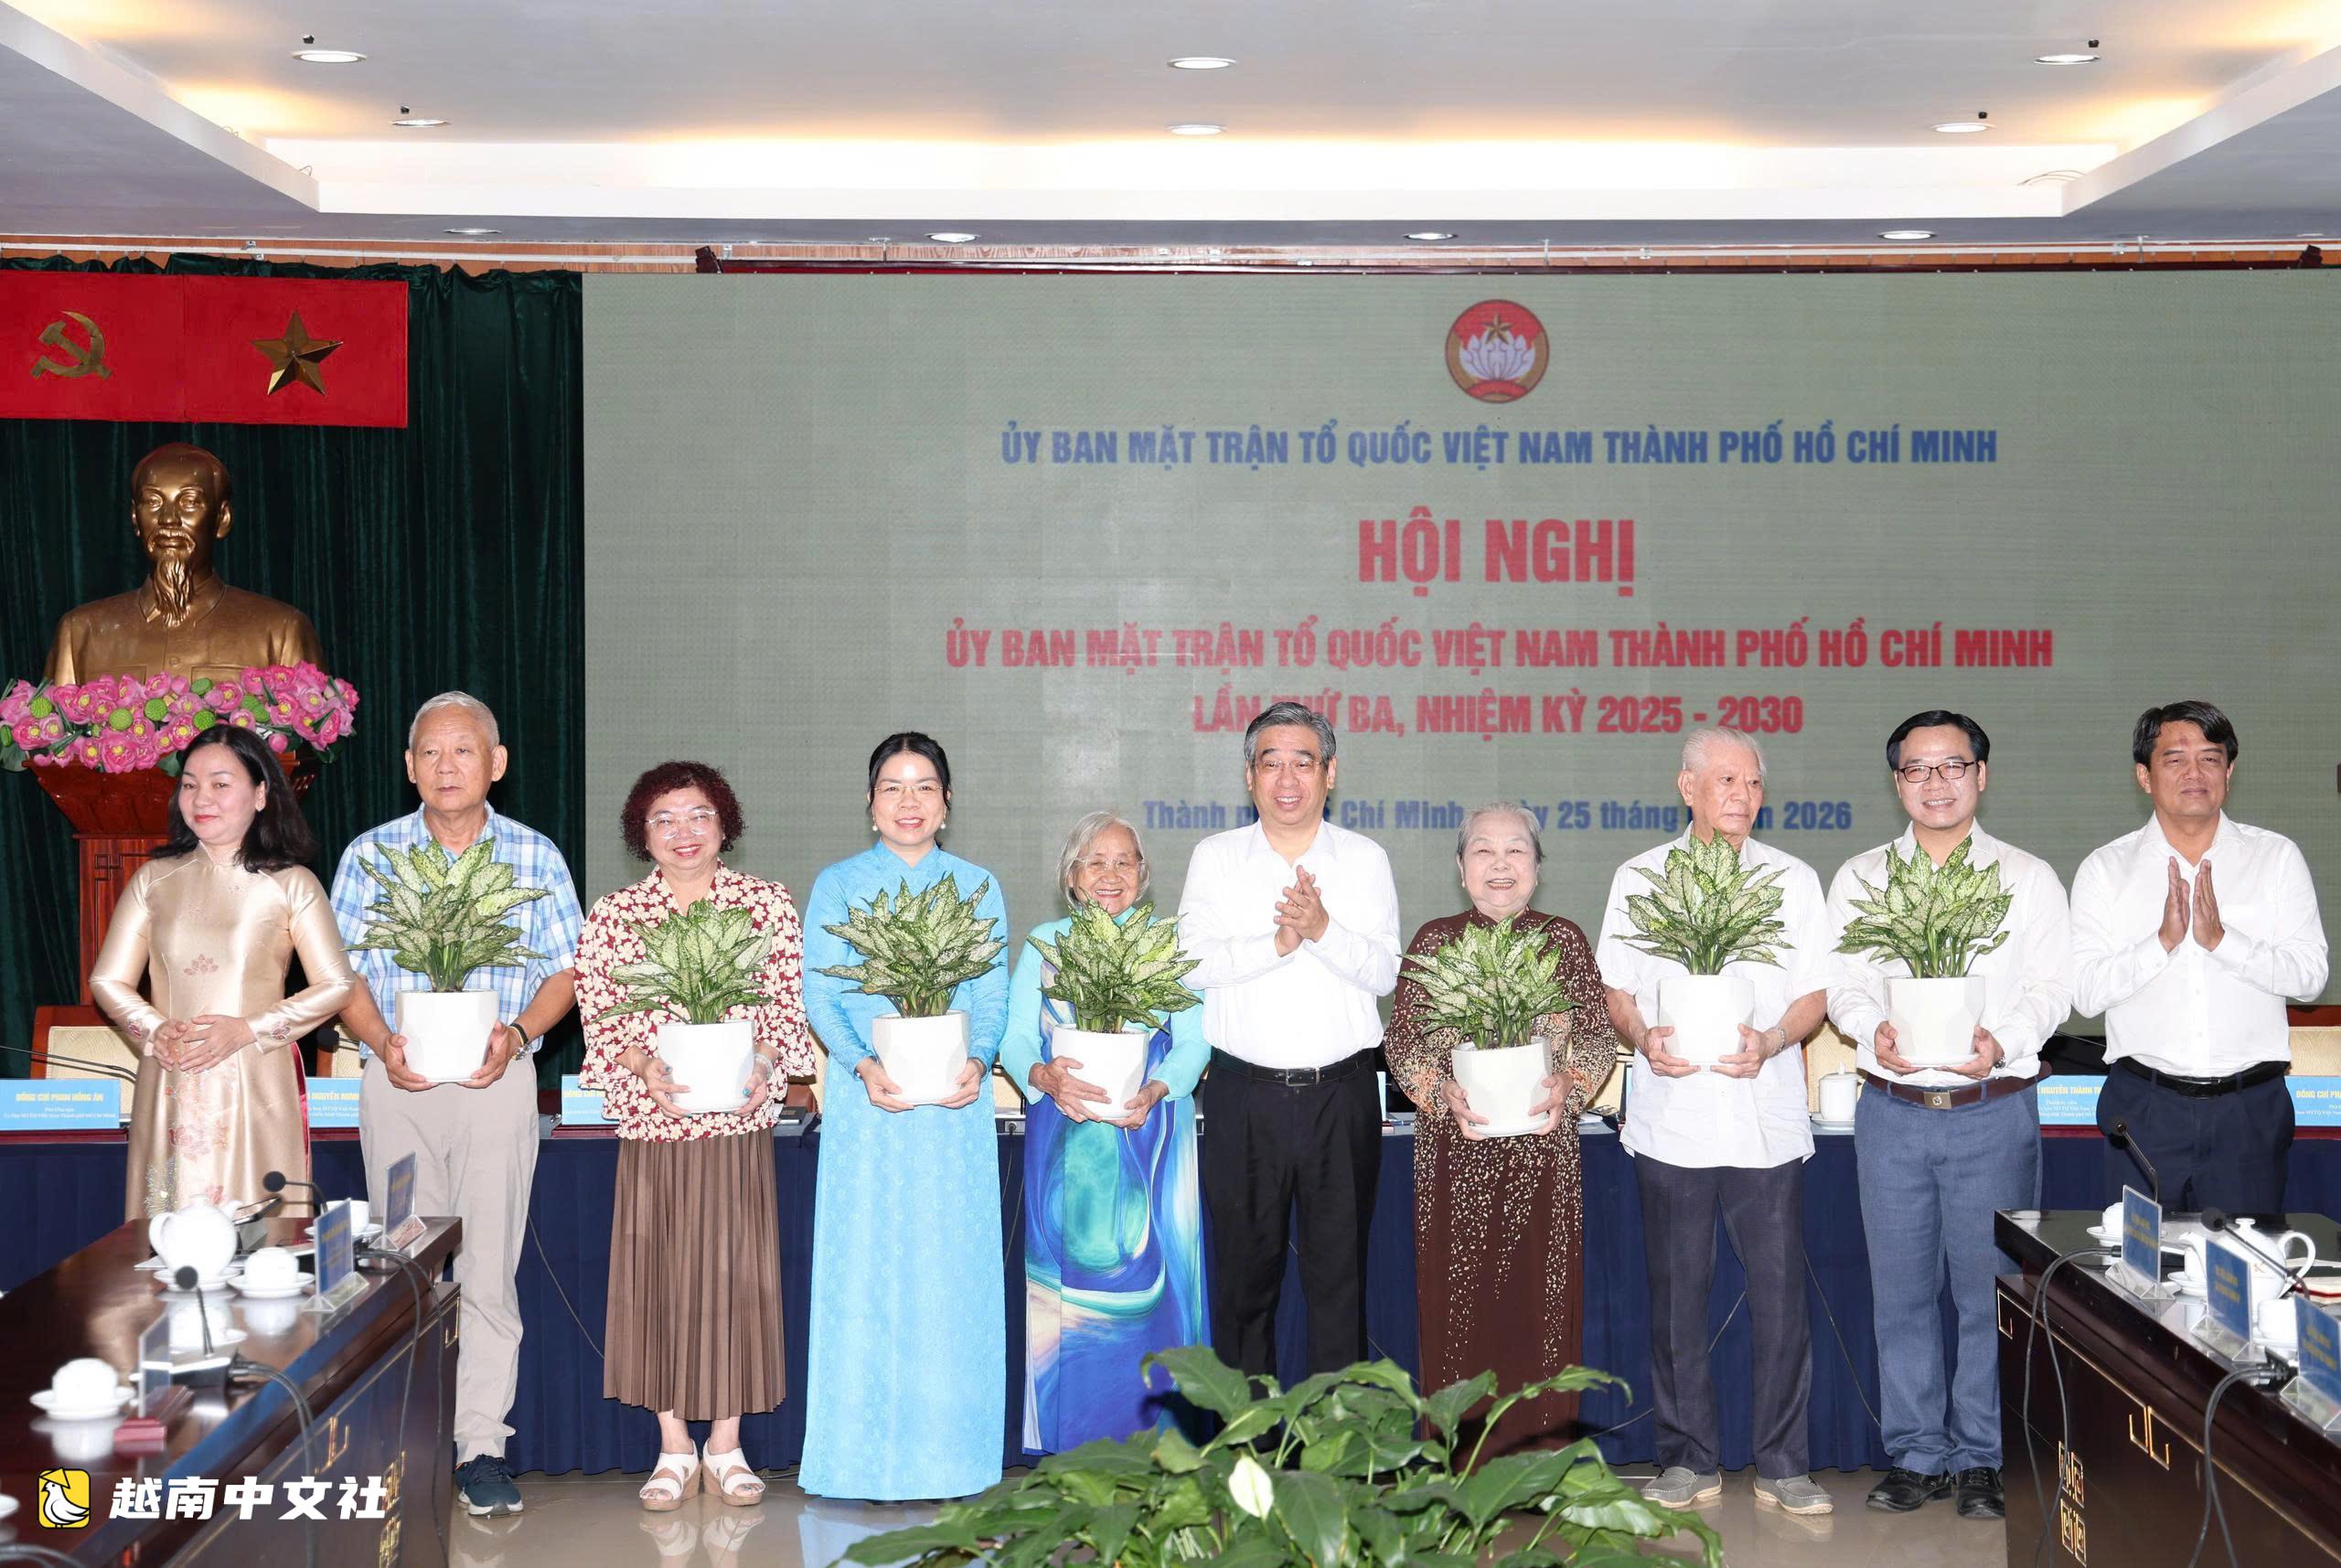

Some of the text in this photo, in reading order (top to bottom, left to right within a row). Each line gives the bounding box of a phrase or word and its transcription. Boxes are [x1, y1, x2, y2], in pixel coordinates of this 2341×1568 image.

[1000, 418, 1998, 472] ỦY BAN MẶT TRẬN TỔ QUỐC VIỆT NAM THÀNH PHỐ HỒ CHÍ MINH
[1359, 507, 1635, 597] HỘI NGHỊ
[946, 616, 2054, 675] ỦY BAN MẶT TRẬN TỔ QUỐC VIỆT NAM THÀNH PHỐ HỒ CHÍ MINH
[1193, 684, 1260, 732] LẦN
[1349, 696, 1405, 737] BA,
[1416, 688, 1531, 741] NHIỆM
[1542, 688, 1587, 732] KỲ
[1597, 696, 1684, 733] 2025
[1717, 696, 1803, 733] 2030
[1143, 800, 1226, 829] Thành
[1341, 800, 1385, 830] Chí
[1556, 800, 1592, 830] 25
[1599, 801, 1679, 833] tháng
[1782, 801, 1853, 831] 2026
